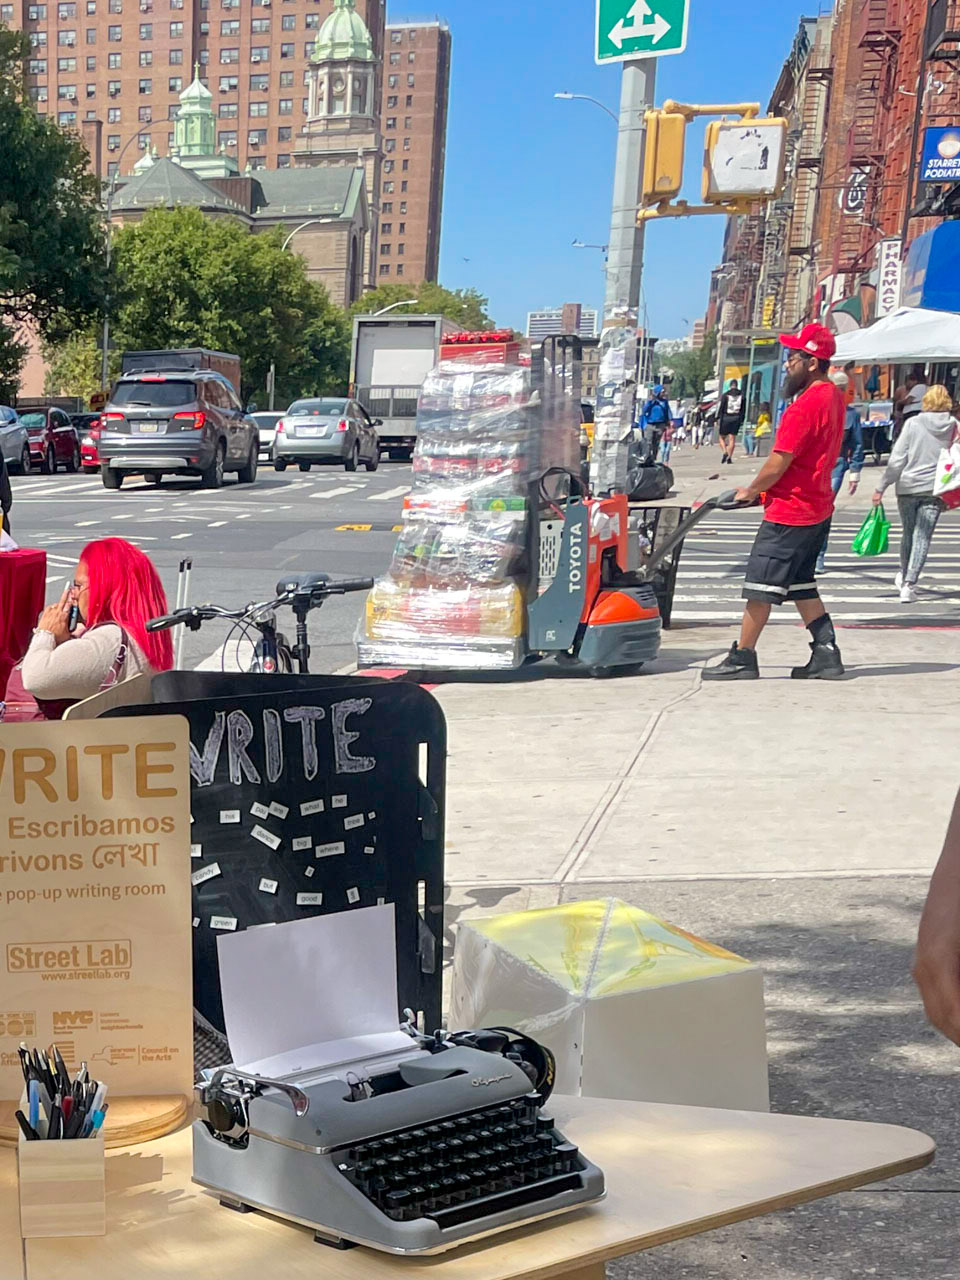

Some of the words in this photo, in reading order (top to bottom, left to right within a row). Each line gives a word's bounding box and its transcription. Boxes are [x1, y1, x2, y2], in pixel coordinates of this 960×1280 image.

[881, 243, 899, 313] PHARMACY
[569, 522, 582, 593] TOYOTA
[8, 814, 176, 840] Escribamos
[194, 868, 214, 881] candy
[6, 886, 62, 904] pop-up
[66, 883, 121, 900] writing
[125, 883, 166, 896] room
[301, 895, 318, 903] good
[9, 945, 81, 969] Street
[86, 944, 129, 967] Lab
[41, 970, 130, 981] www.streetlab.org
[53, 1011, 94, 1025] NYC
[141, 1046, 168, 1054] Council
[155, 1054, 172, 1062] Arts
